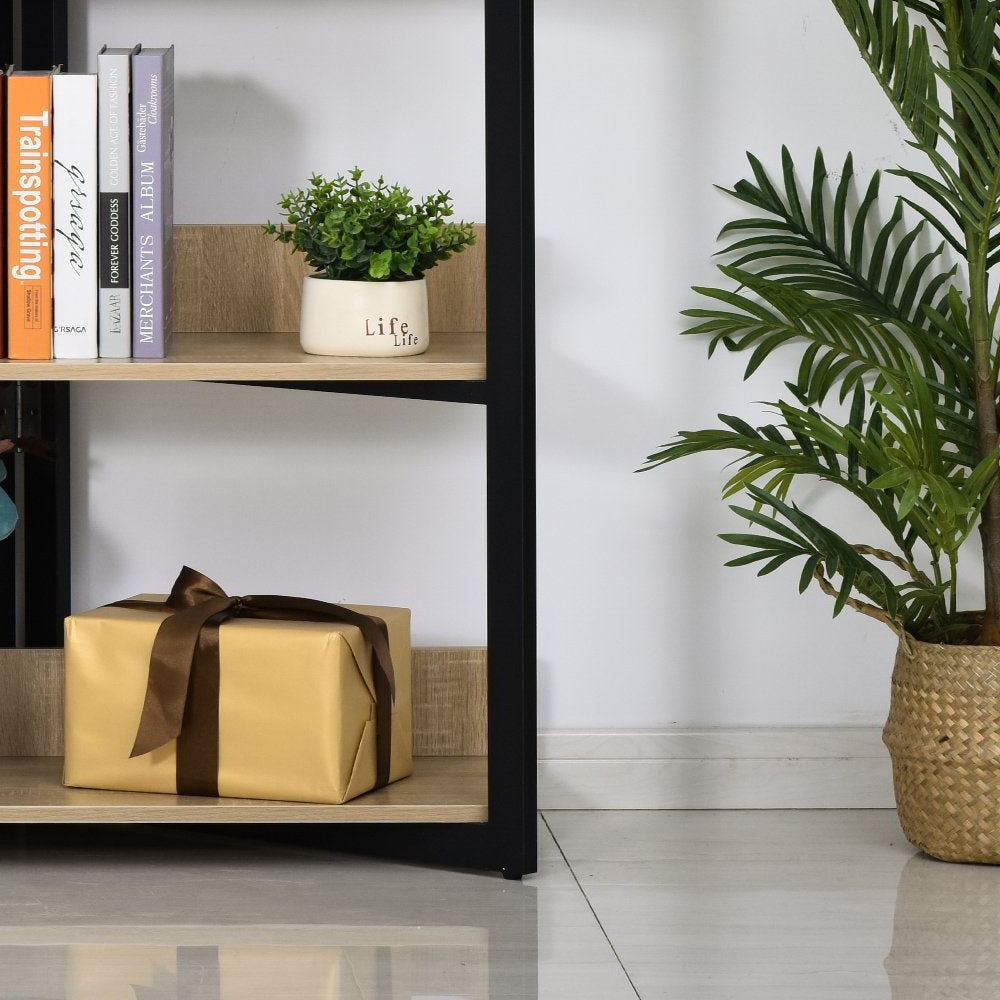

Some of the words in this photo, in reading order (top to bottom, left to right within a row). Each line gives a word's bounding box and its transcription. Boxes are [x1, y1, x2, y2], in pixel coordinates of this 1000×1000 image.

[148, 74, 158, 125] Cloakrooms
[109, 126, 118, 145] AGE
[109, 147, 119, 186] GOLDEN
[11, 110, 49, 281] Trainspotting
[140, 161, 155, 222] ALBUM
[109, 198, 119, 242] GODDESS
[110, 244, 119, 283] FOREVER
[139, 235, 154, 344] MERCHANTS
[365, 317, 409, 336] Life
[393, 333, 419, 347] Life
